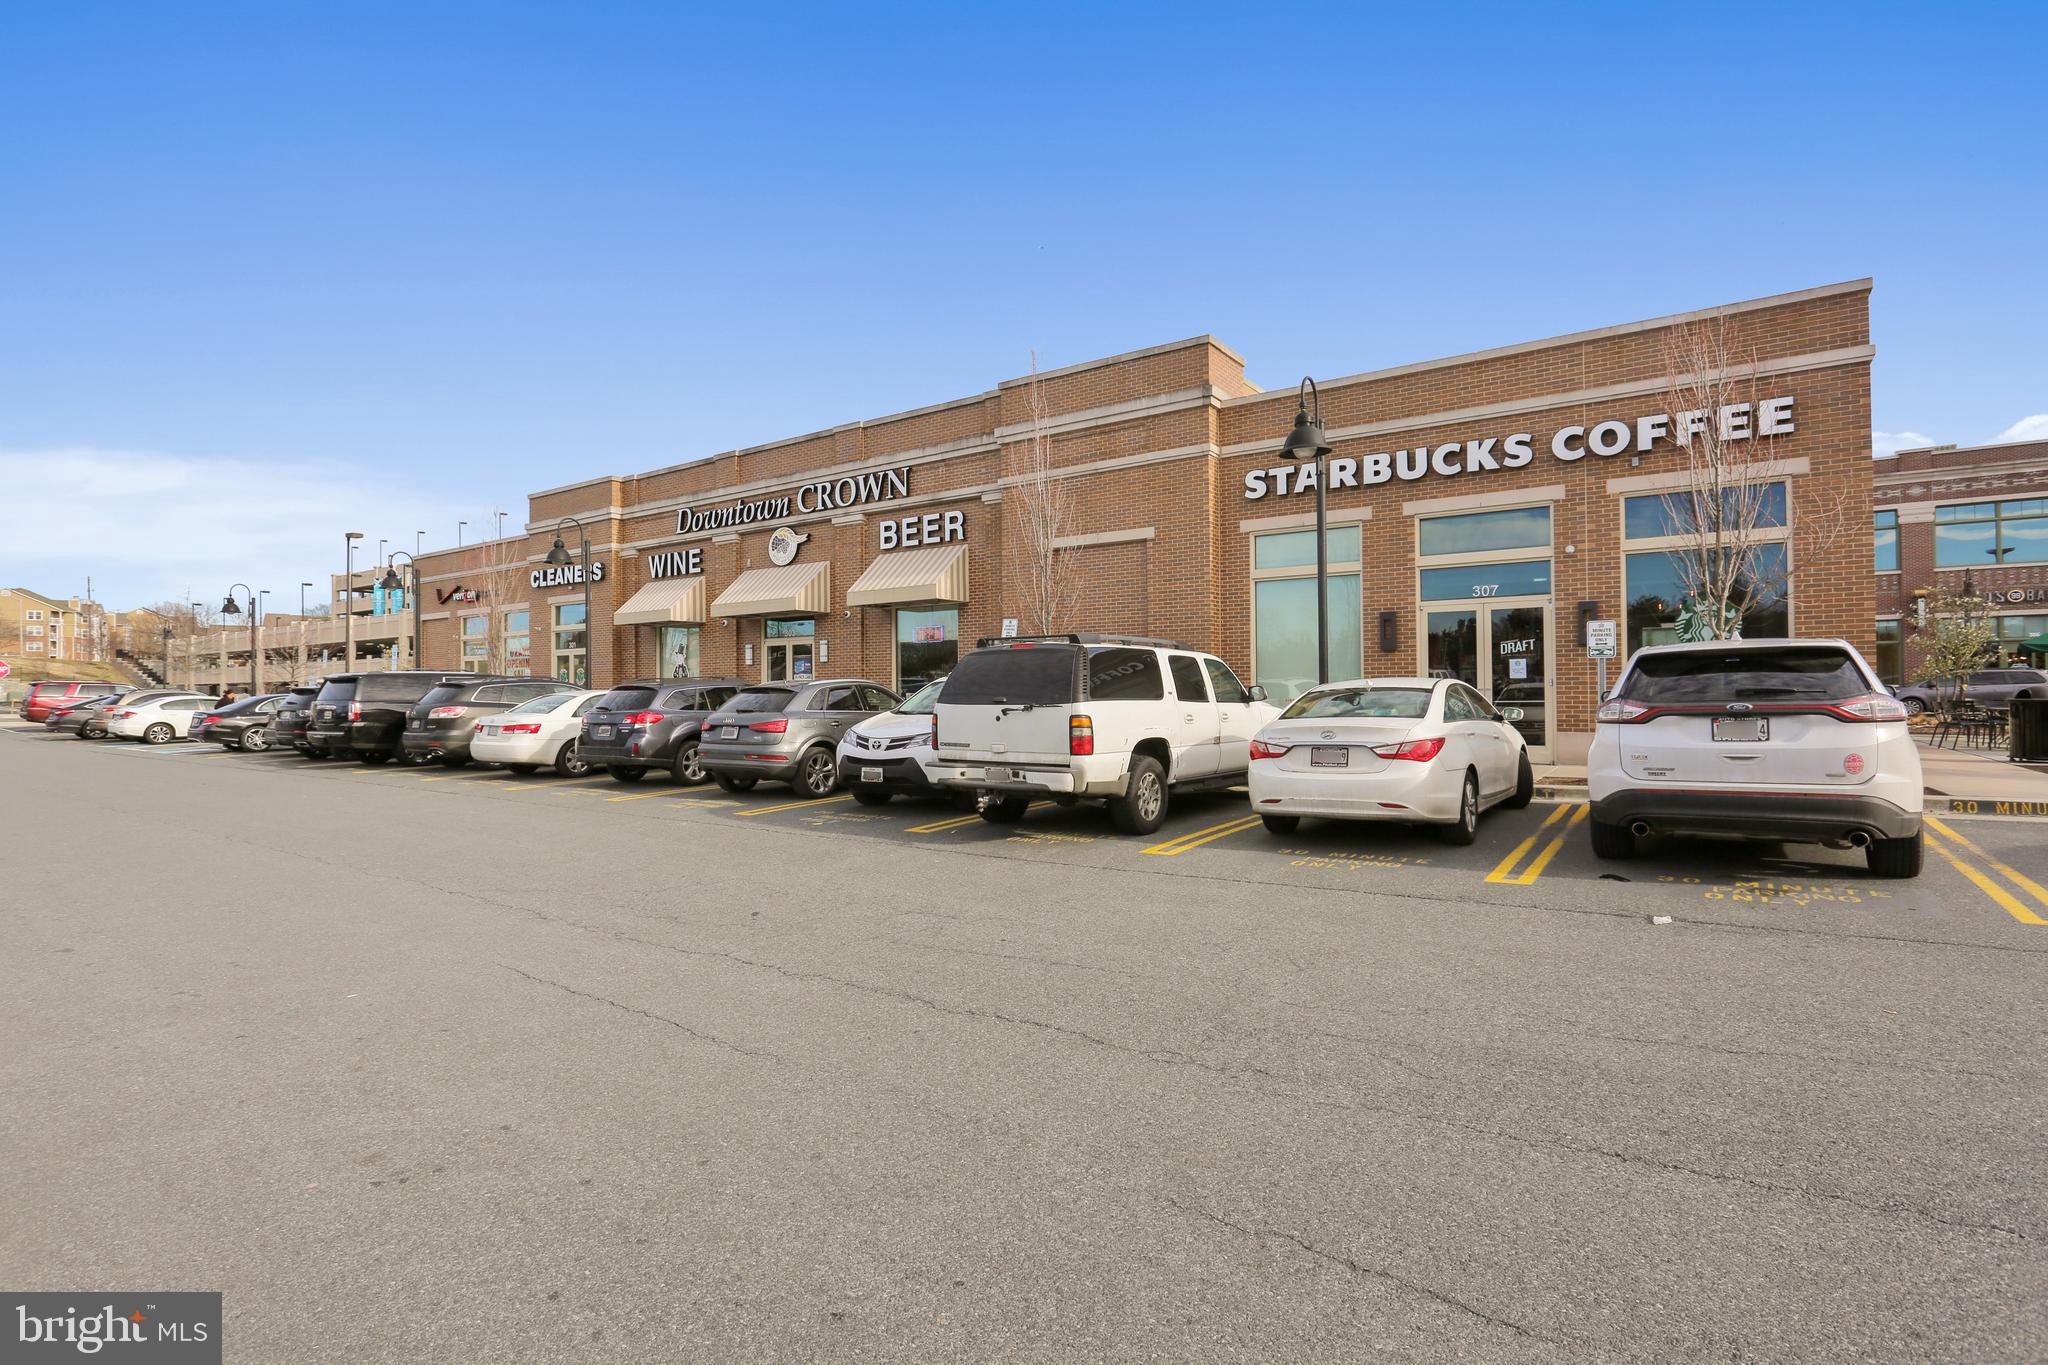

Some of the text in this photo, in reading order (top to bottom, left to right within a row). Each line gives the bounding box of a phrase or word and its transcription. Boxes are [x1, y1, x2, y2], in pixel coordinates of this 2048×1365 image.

[1244, 396, 1795, 499] STARBUCKS COFFEE
[676, 467, 911, 534] Downtown CROWN
[879, 510, 965, 550] BEER
[648, 548, 702, 578] WINE
[1472, 584, 1499, 597] 307
[568, 641, 577, 649] 301
[1500, 639, 1536, 655] DRAFT
[1953, 801, 2047, 815] 30 MINU
